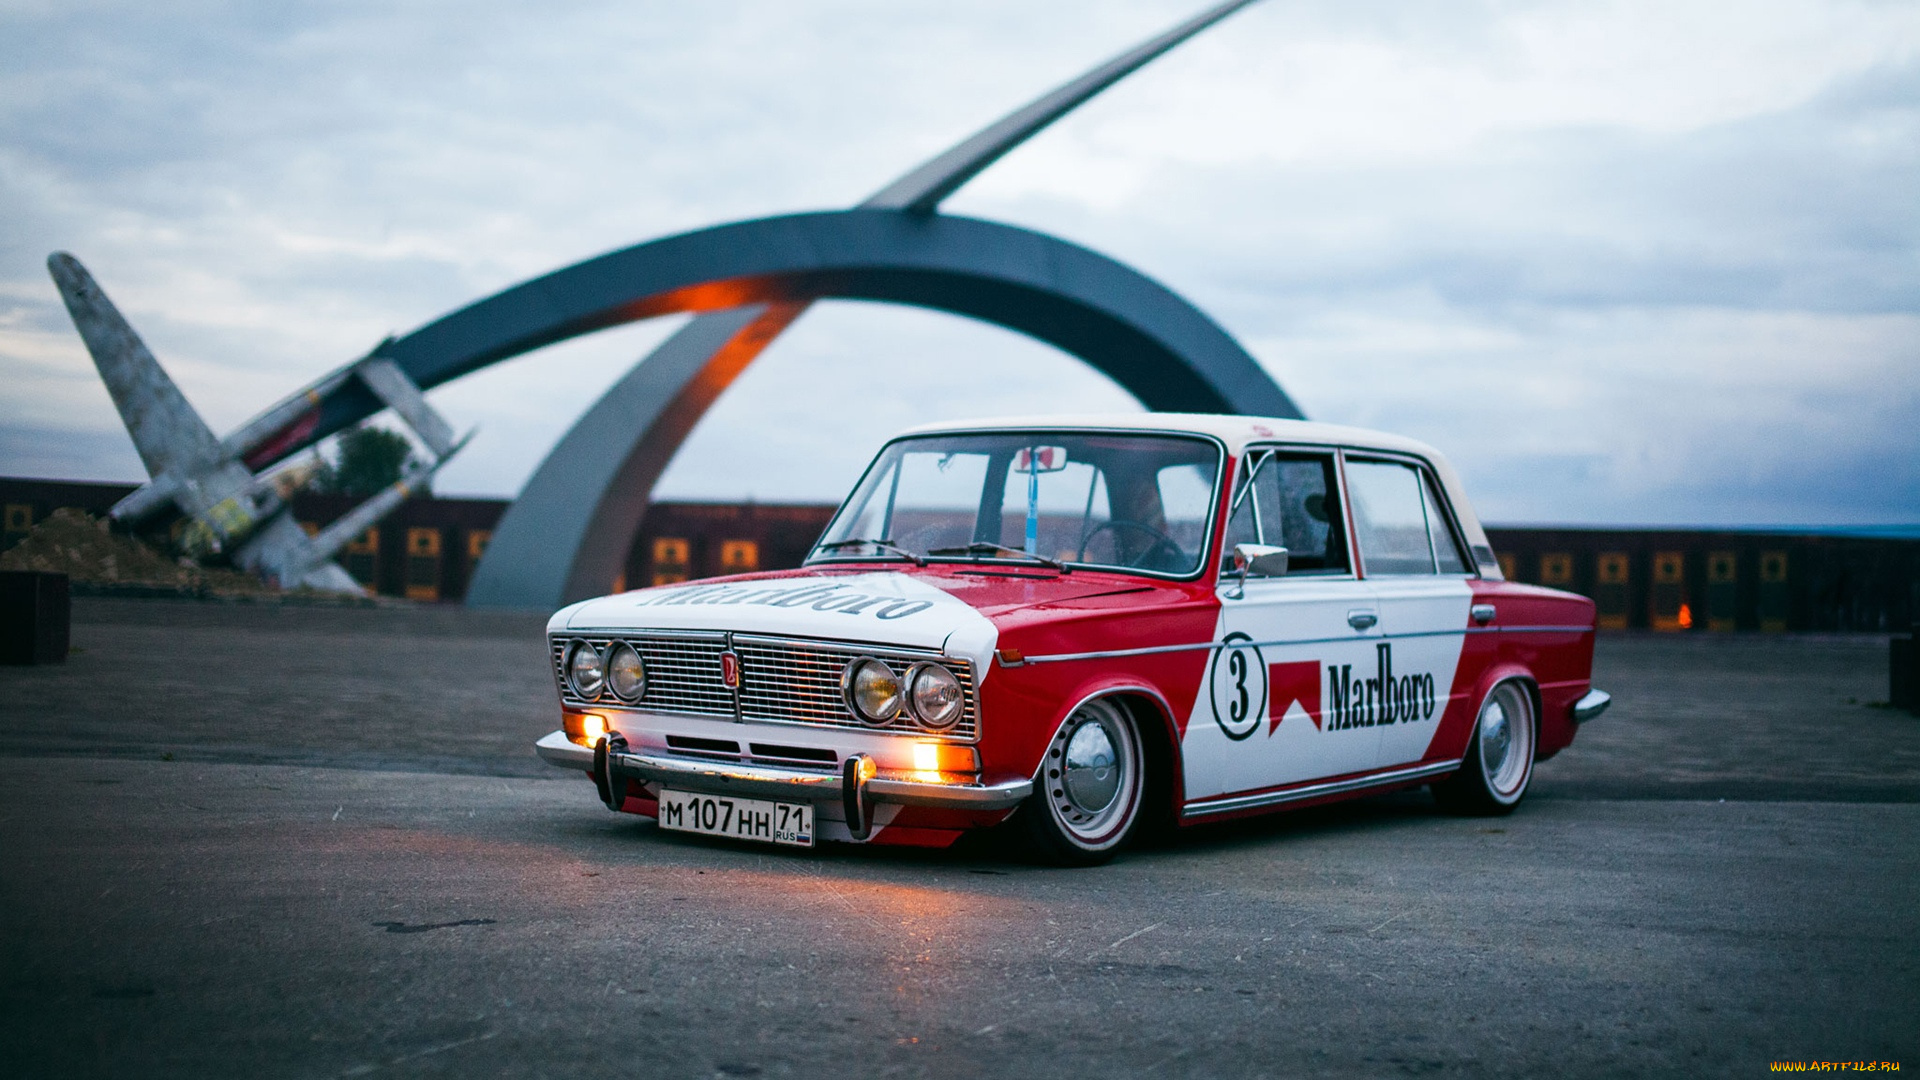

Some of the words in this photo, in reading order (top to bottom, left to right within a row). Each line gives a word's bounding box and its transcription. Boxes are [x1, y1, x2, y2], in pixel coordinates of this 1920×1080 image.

[637, 583, 934, 619] Marlboro
[1229, 649, 1249, 723] 3
[1327, 642, 1436, 732] Marlboro
[775, 830, 796, 841] RUS
[778, 805, 803, 832] 71
